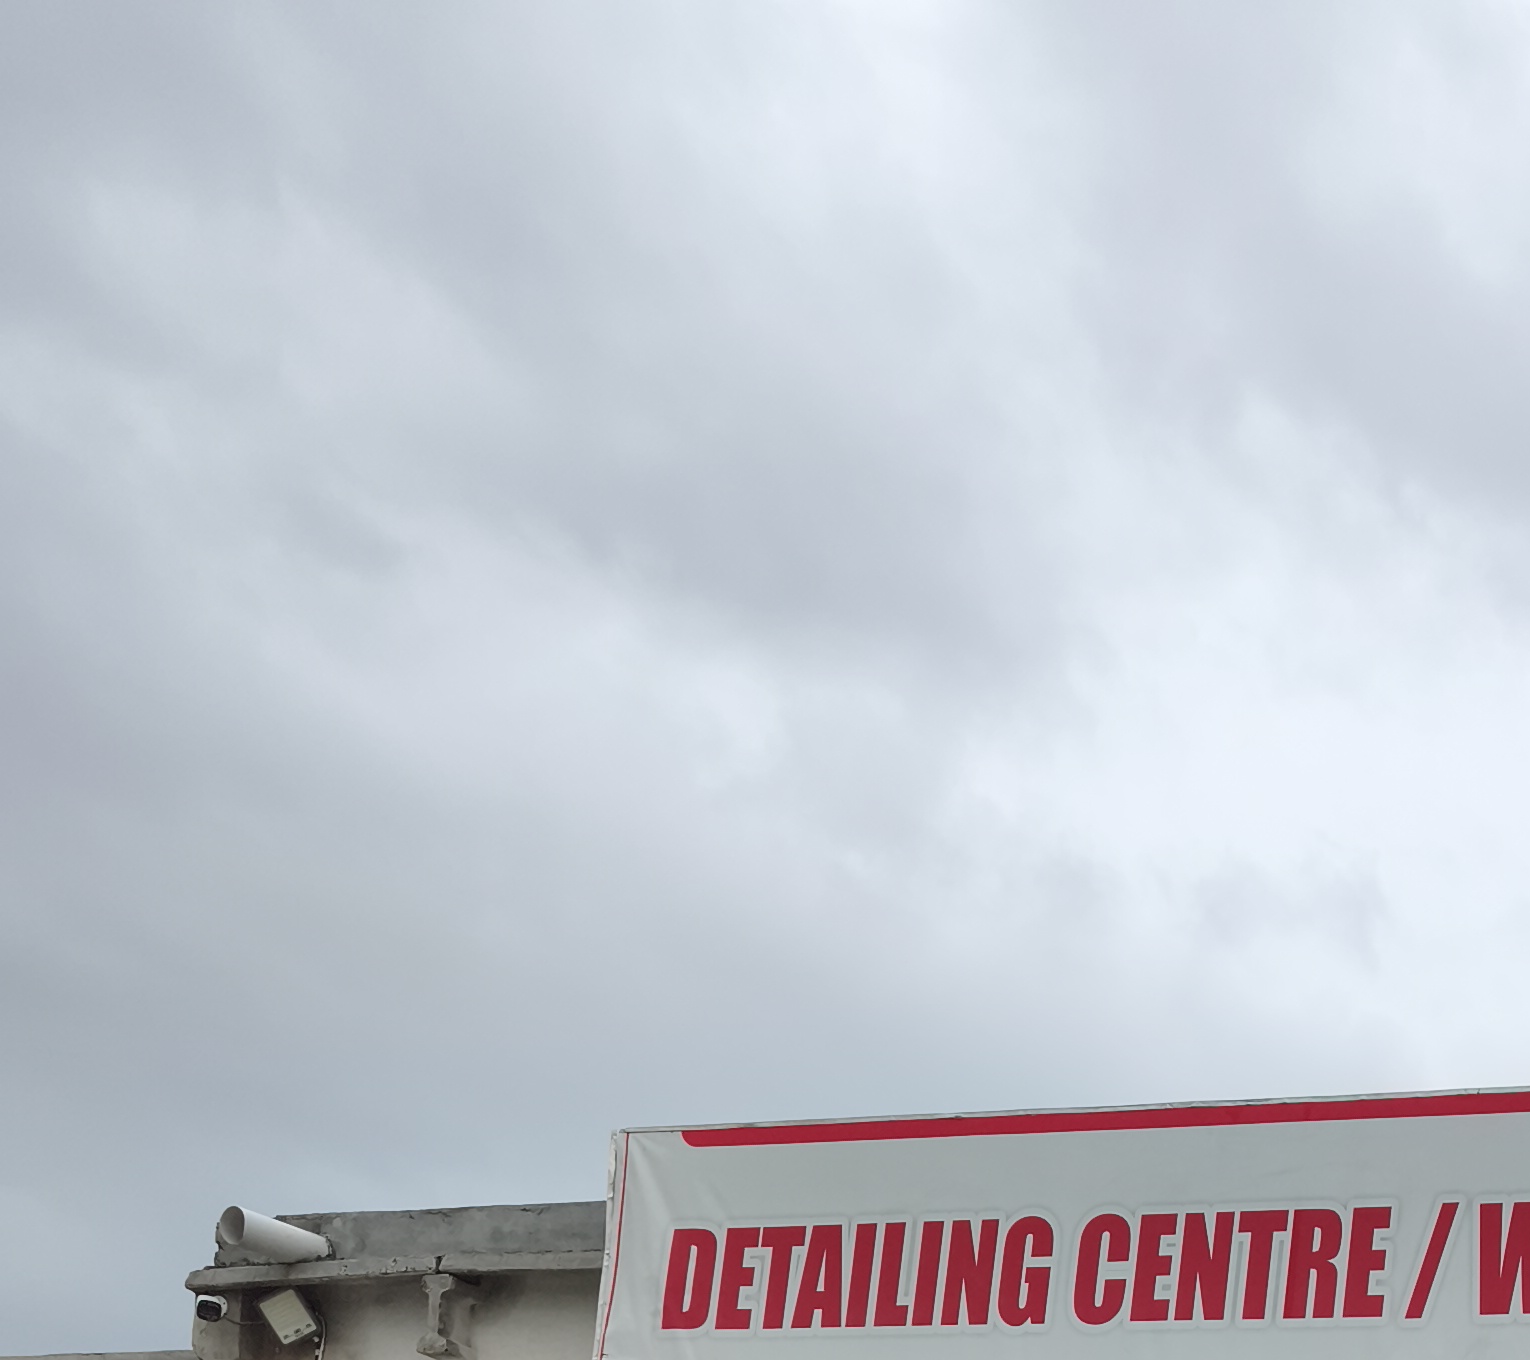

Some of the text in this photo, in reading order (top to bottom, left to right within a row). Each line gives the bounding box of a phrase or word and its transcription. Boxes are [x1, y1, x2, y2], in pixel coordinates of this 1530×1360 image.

[660, 1216, 1053, 1331] DETAILING
[1073, 1207, 1391, 1326] CENTRE
[1403, 1203, 1459, 1319] /
